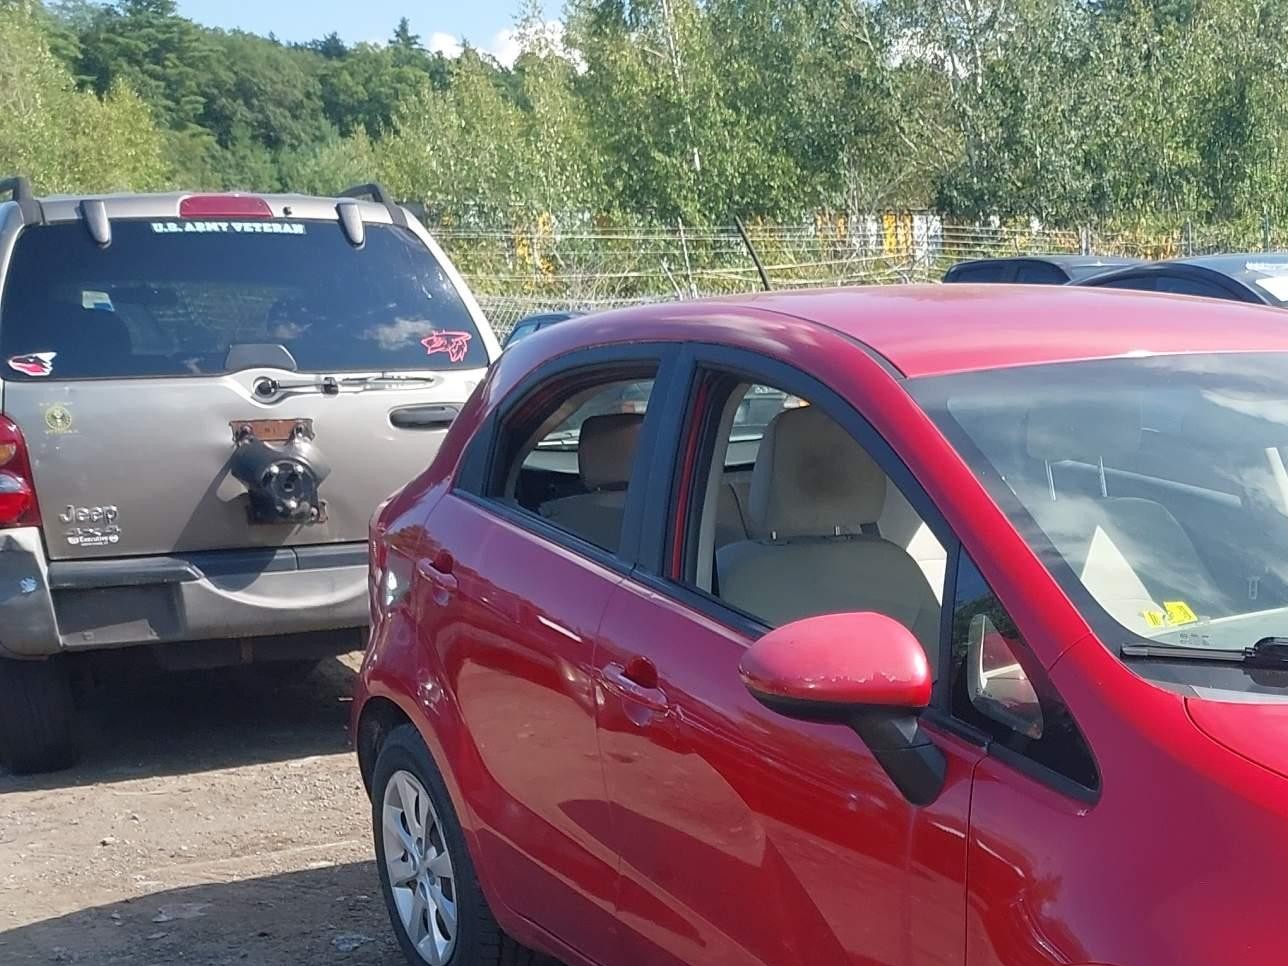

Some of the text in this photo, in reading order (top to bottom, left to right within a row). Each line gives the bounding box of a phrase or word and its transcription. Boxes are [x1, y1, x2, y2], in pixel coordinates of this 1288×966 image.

[184, 222, 229, 233] ARMY
[231, 223, 305, 234] VETERAN
[58, 504, 119, 525] Jeep
